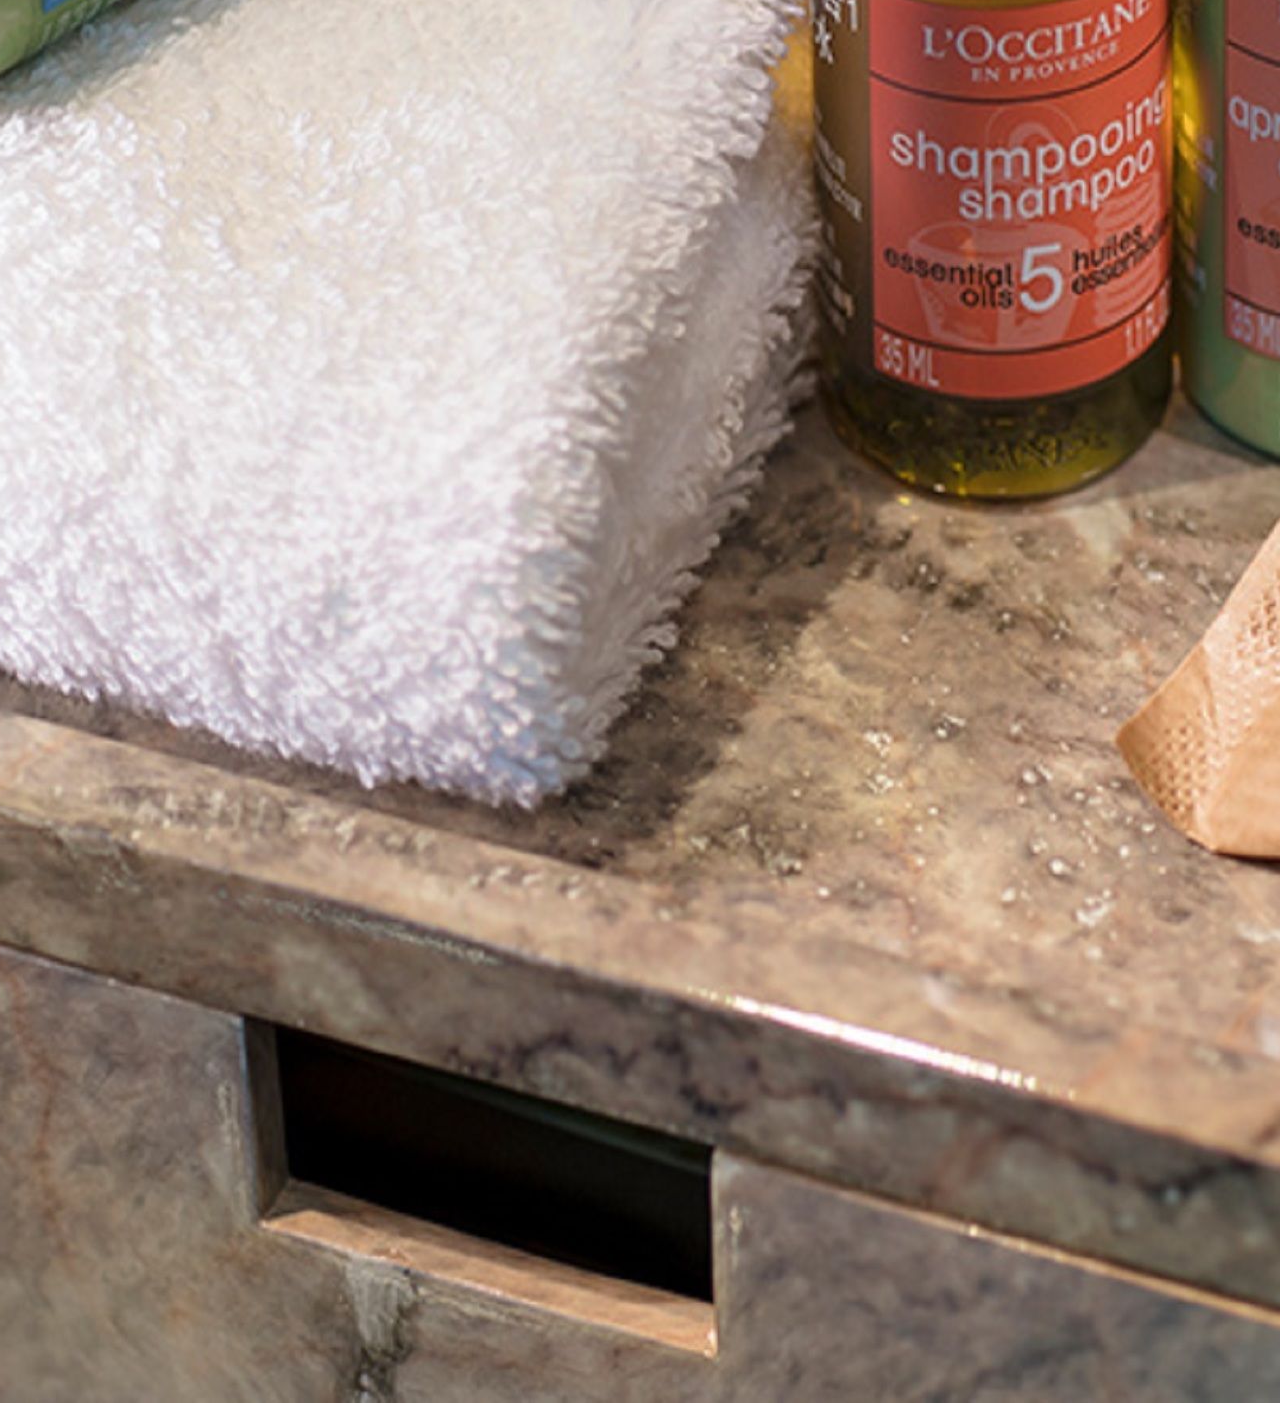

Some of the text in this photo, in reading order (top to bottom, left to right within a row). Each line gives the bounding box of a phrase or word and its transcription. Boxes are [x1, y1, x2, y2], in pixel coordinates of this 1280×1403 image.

[971, 41, 1120, 84] EN PROVENCE
[958, 138, 1156, 222] shampoo
[883, 245, 1015, 290] essential
[1019, 242, 1064, 313] 5
[960, 284, 1014, 310] oils
[907, 344, 940, 388] ML
